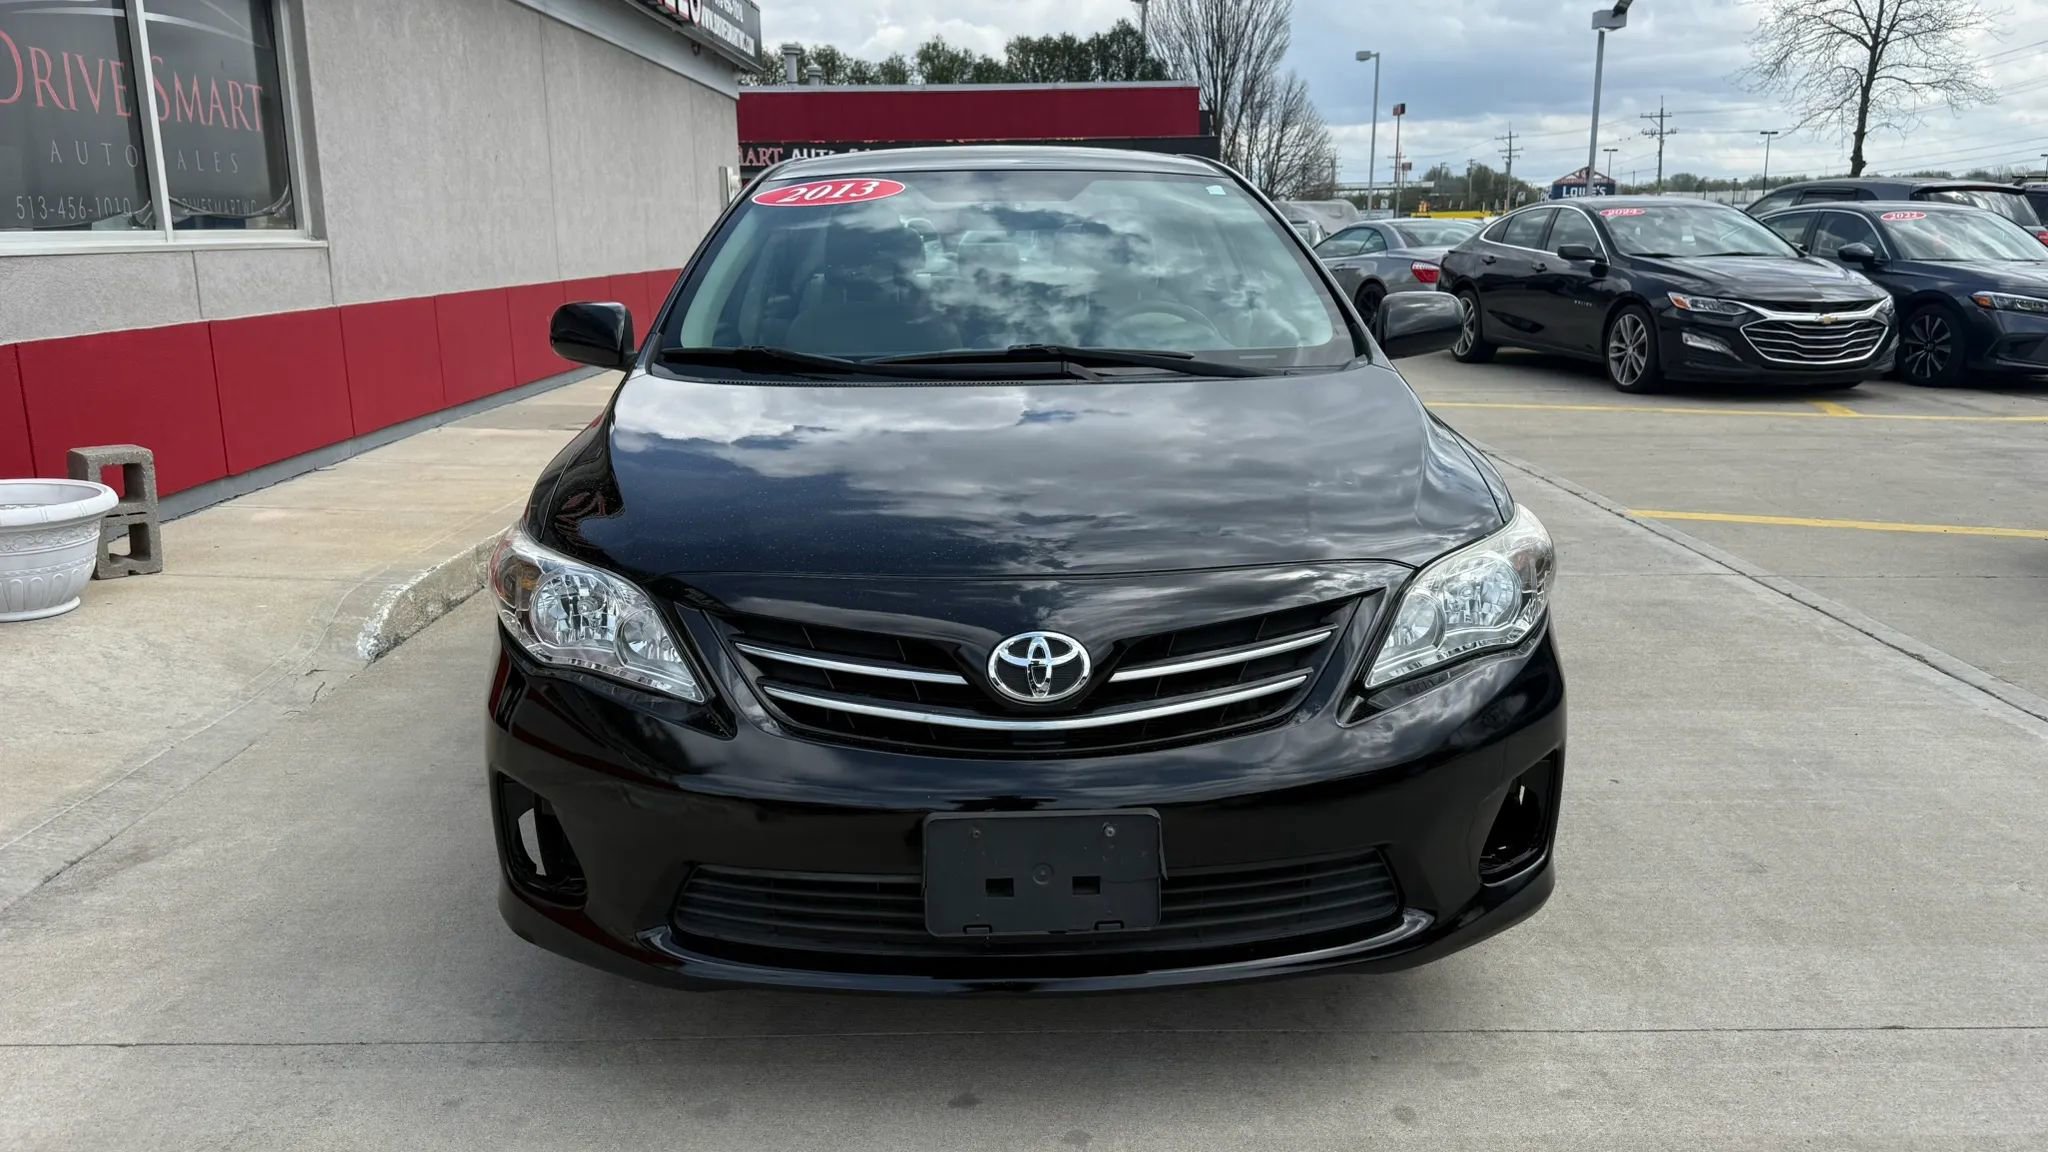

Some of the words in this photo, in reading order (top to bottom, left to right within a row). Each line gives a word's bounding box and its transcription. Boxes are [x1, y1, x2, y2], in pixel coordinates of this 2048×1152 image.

[153, 55, 263, 132] SMART
[50, 140, 139, 168] AUTO
[177, 149, 239, 173] ALES
[776, 181, 880, 203] 2013
[16, 196, 134, 219] 513-456-1010
